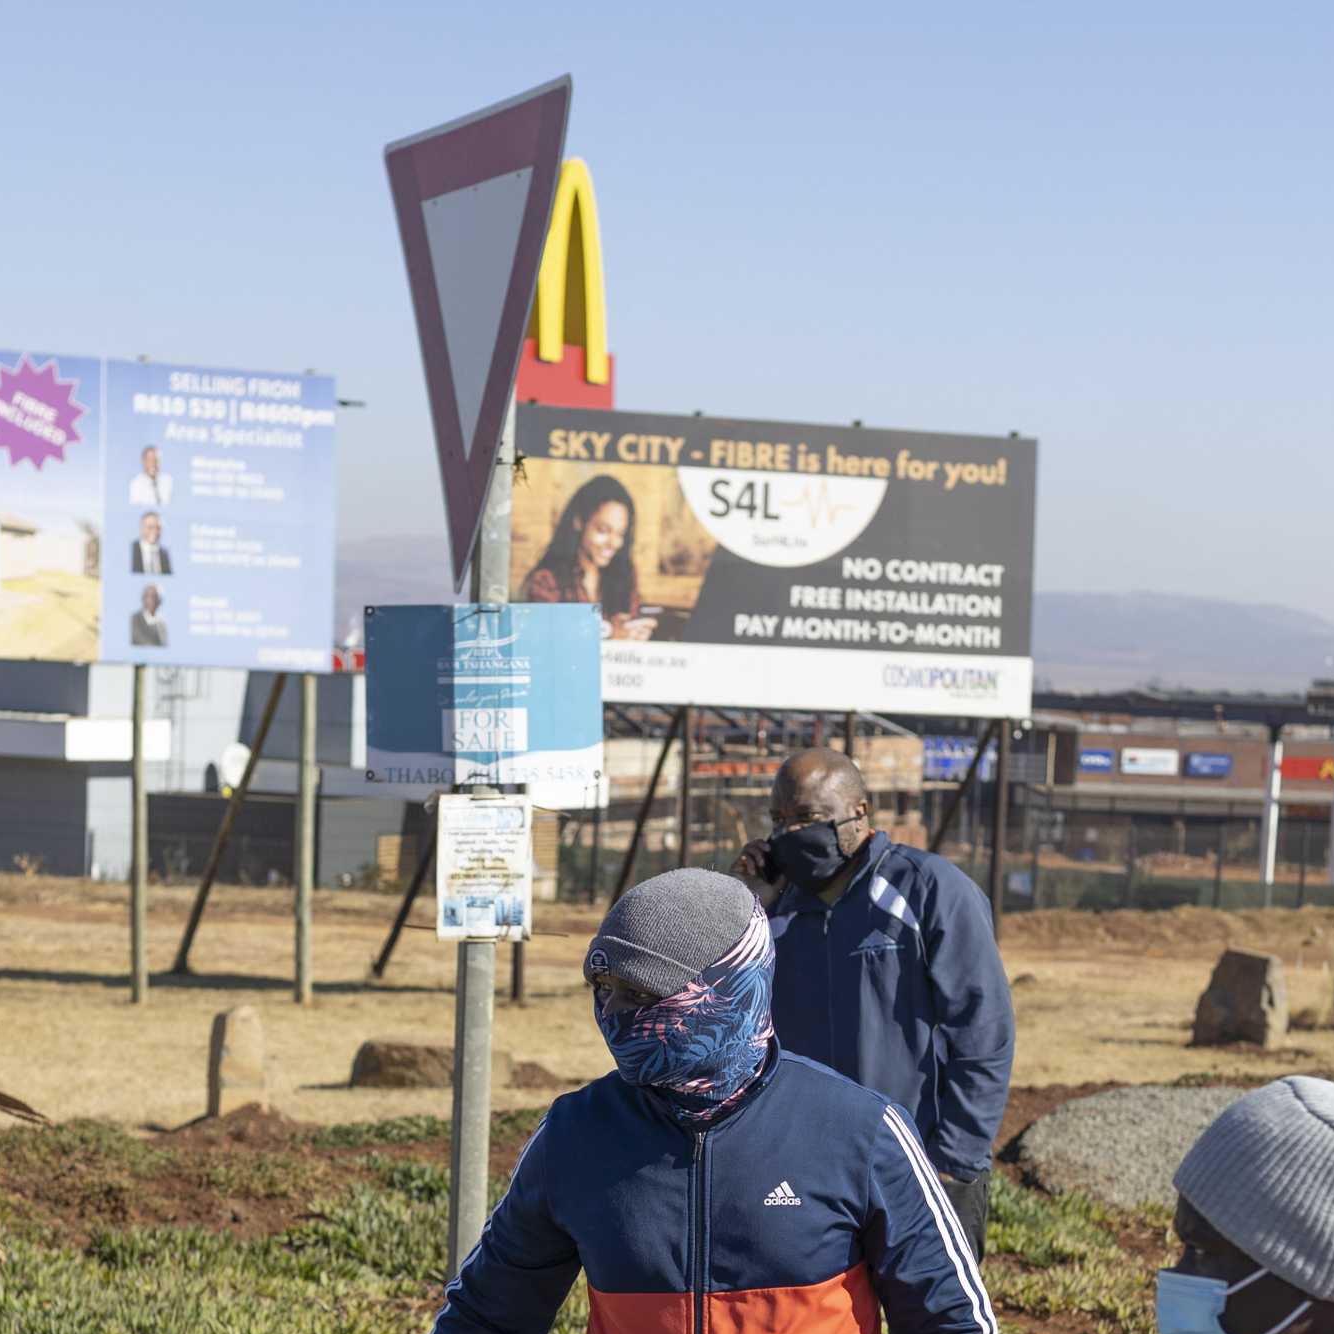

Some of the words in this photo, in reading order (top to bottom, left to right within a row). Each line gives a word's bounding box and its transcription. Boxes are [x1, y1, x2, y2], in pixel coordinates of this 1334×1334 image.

[169, 371, 247, 397] SELLING
[247, 377, 303, 400] FROM
[11, 390, 60, 426] FIBRE
[165, 420, 210, 444] Area
[212, 423, 304, 449] Specialist
[548, 428, 612, 460] SKY
[617, 434, 686, 465] CITY
[710, 439, 792, 471] FIBRE
[797, 443, 821, 473] is
[826, 444, 891, 479] here
[896, 449, 940, 481] for
[944, 457, 1007, 490] you!
[709, 479, 780, 520] S4L
[842, 557, 883, 581] NO
[885, 559, 1005, 587] CONTRACT
[790, 585, 843, 610] FREE
[845, 588, 1002, 618] INSTALLATION
[734, 614, 779, 638] PAY
[781, 616, 1002, 649] MONTH-TO-MONTH
[883, 664, 1000, 691] COSMOPOLITAN
[459, 710, 510, 729] FOR
[452, 731, 517, 750] SALE
[384, 767, 455, 784] THABO
[510, 766, 539, 782] 735
[546, 765, 585, 782] 5458
[763, 1196, 801, 1206] adidas
